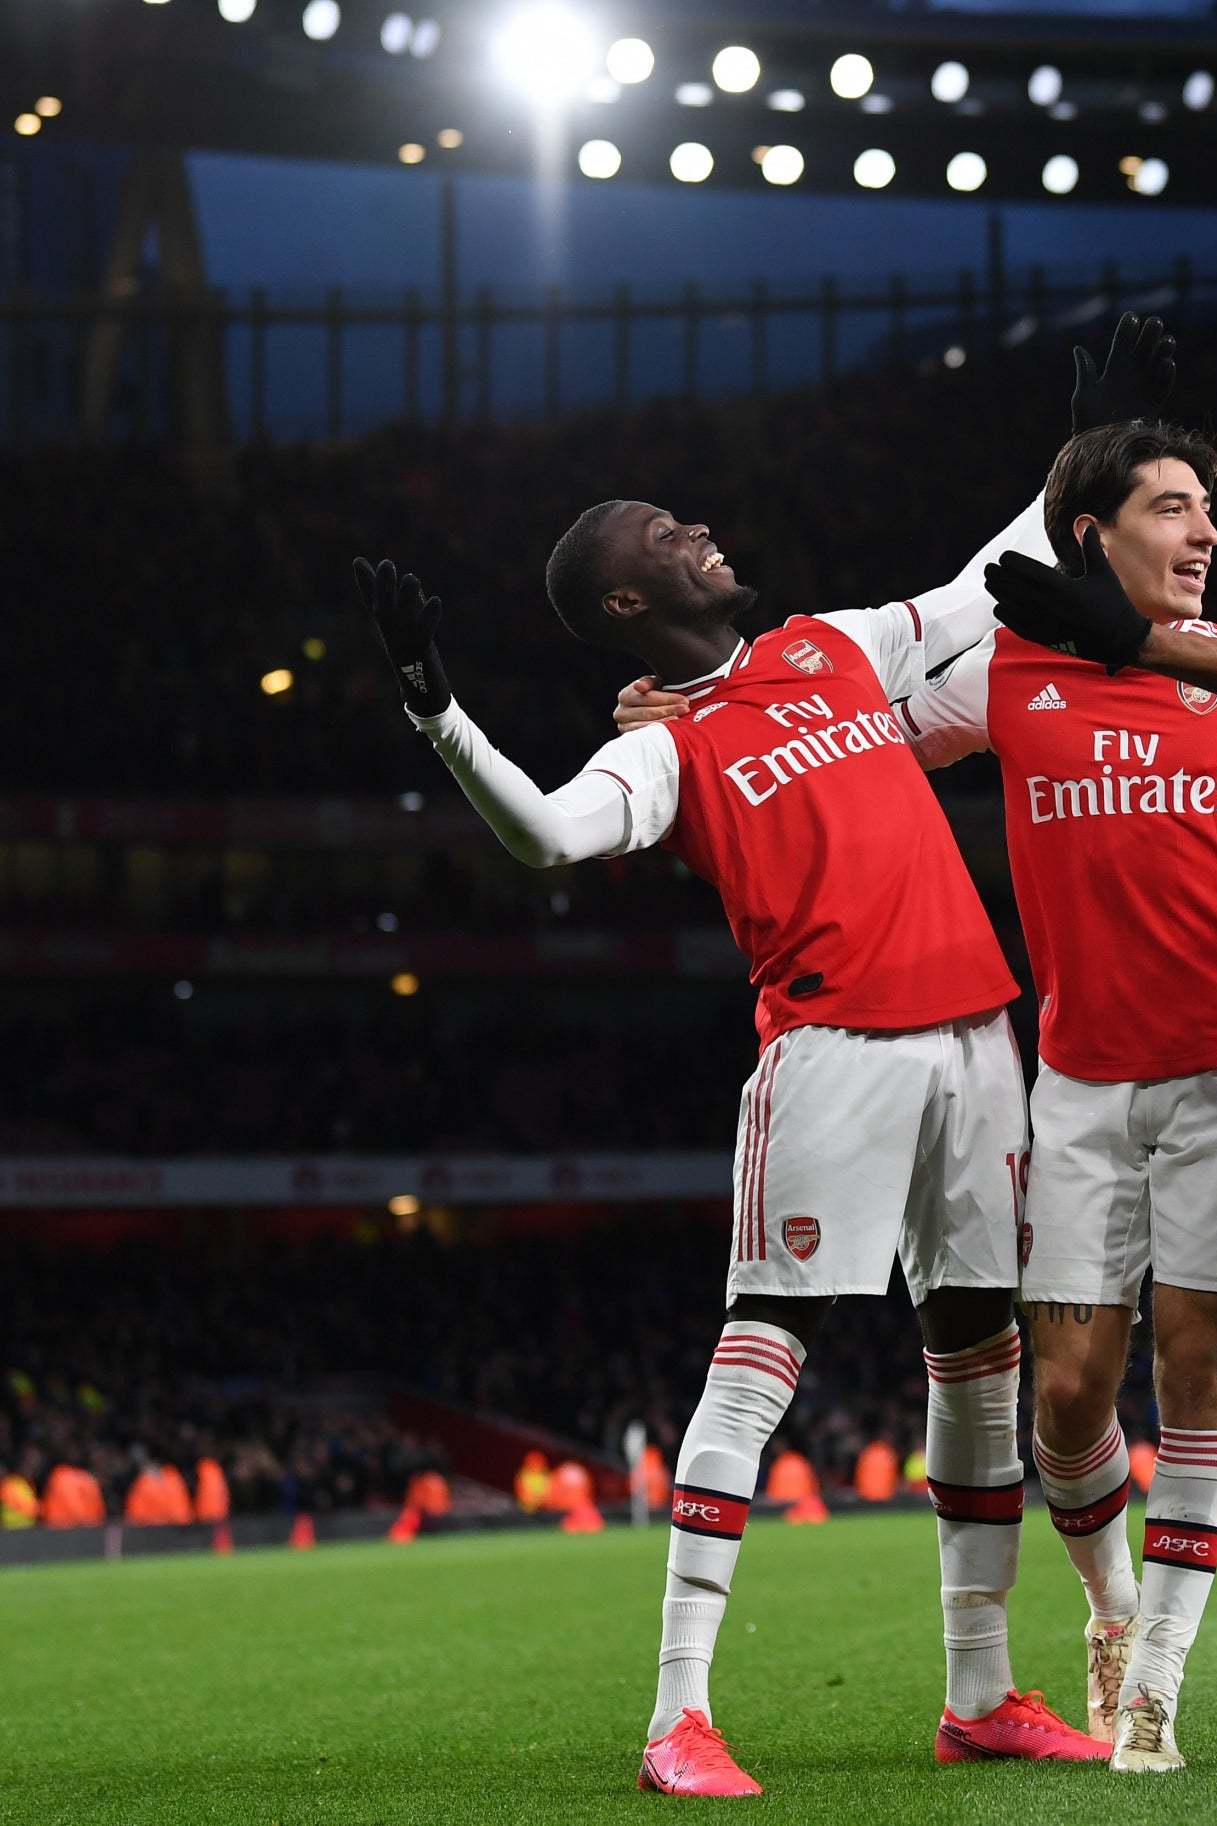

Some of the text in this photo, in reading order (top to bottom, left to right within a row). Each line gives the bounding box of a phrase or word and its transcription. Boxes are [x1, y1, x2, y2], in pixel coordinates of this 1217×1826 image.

[764, 693, 834, 728] Fly
[1027, 699, 1067, 711] adidas
[723, 708, 906, 807] Emirates
[1093, 729, 1160, 767] Fly
[787, 1223, 816, 1232] Arsenal
